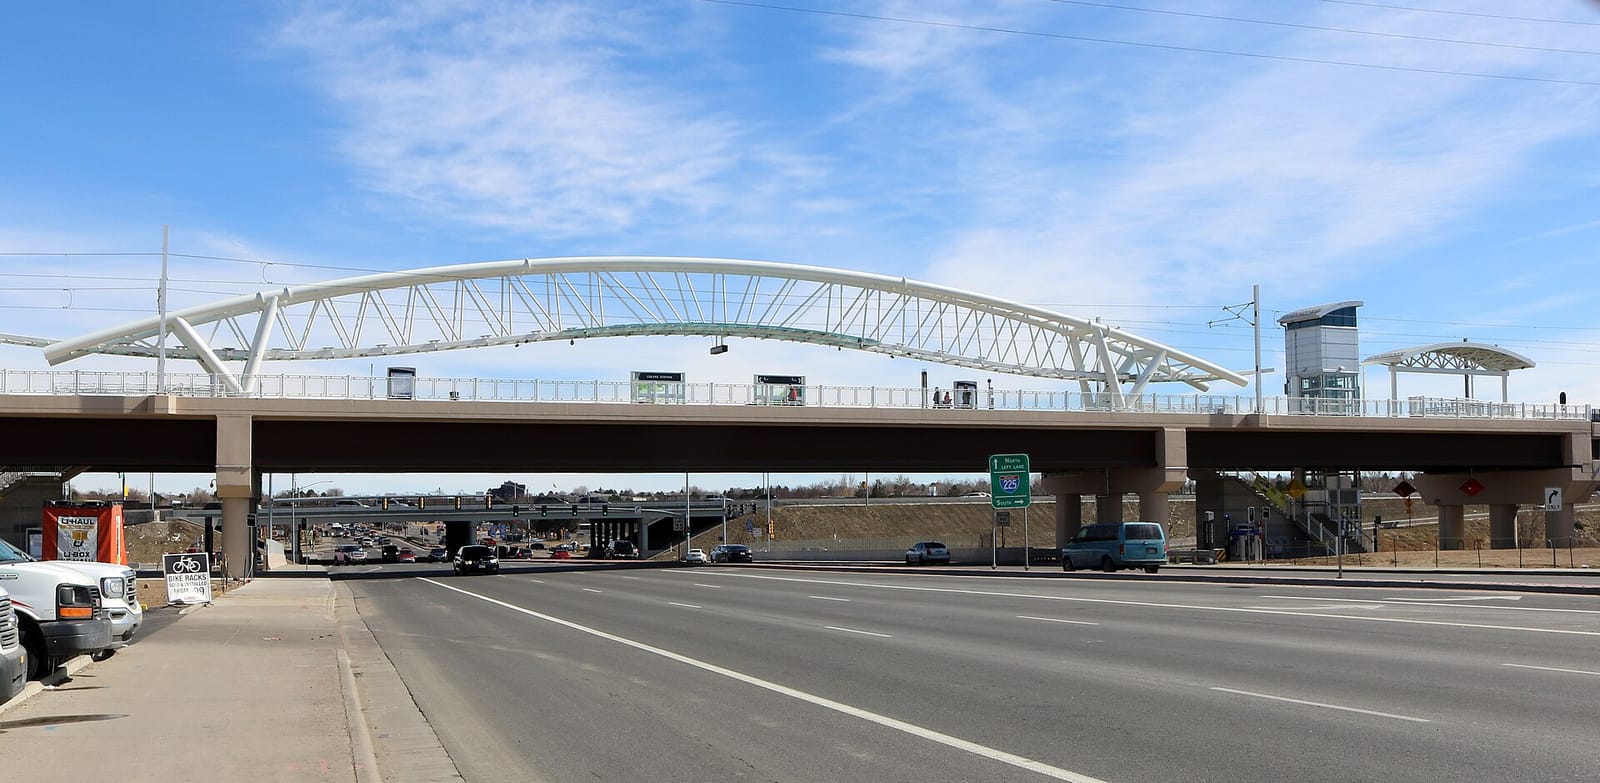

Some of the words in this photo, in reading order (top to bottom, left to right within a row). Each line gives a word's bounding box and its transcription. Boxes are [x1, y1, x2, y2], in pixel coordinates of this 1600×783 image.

[1003, 480, 1016, 490] 225
[168, 574, 184, 583] BIKE
[184, 573, 207, 582] RACKS
